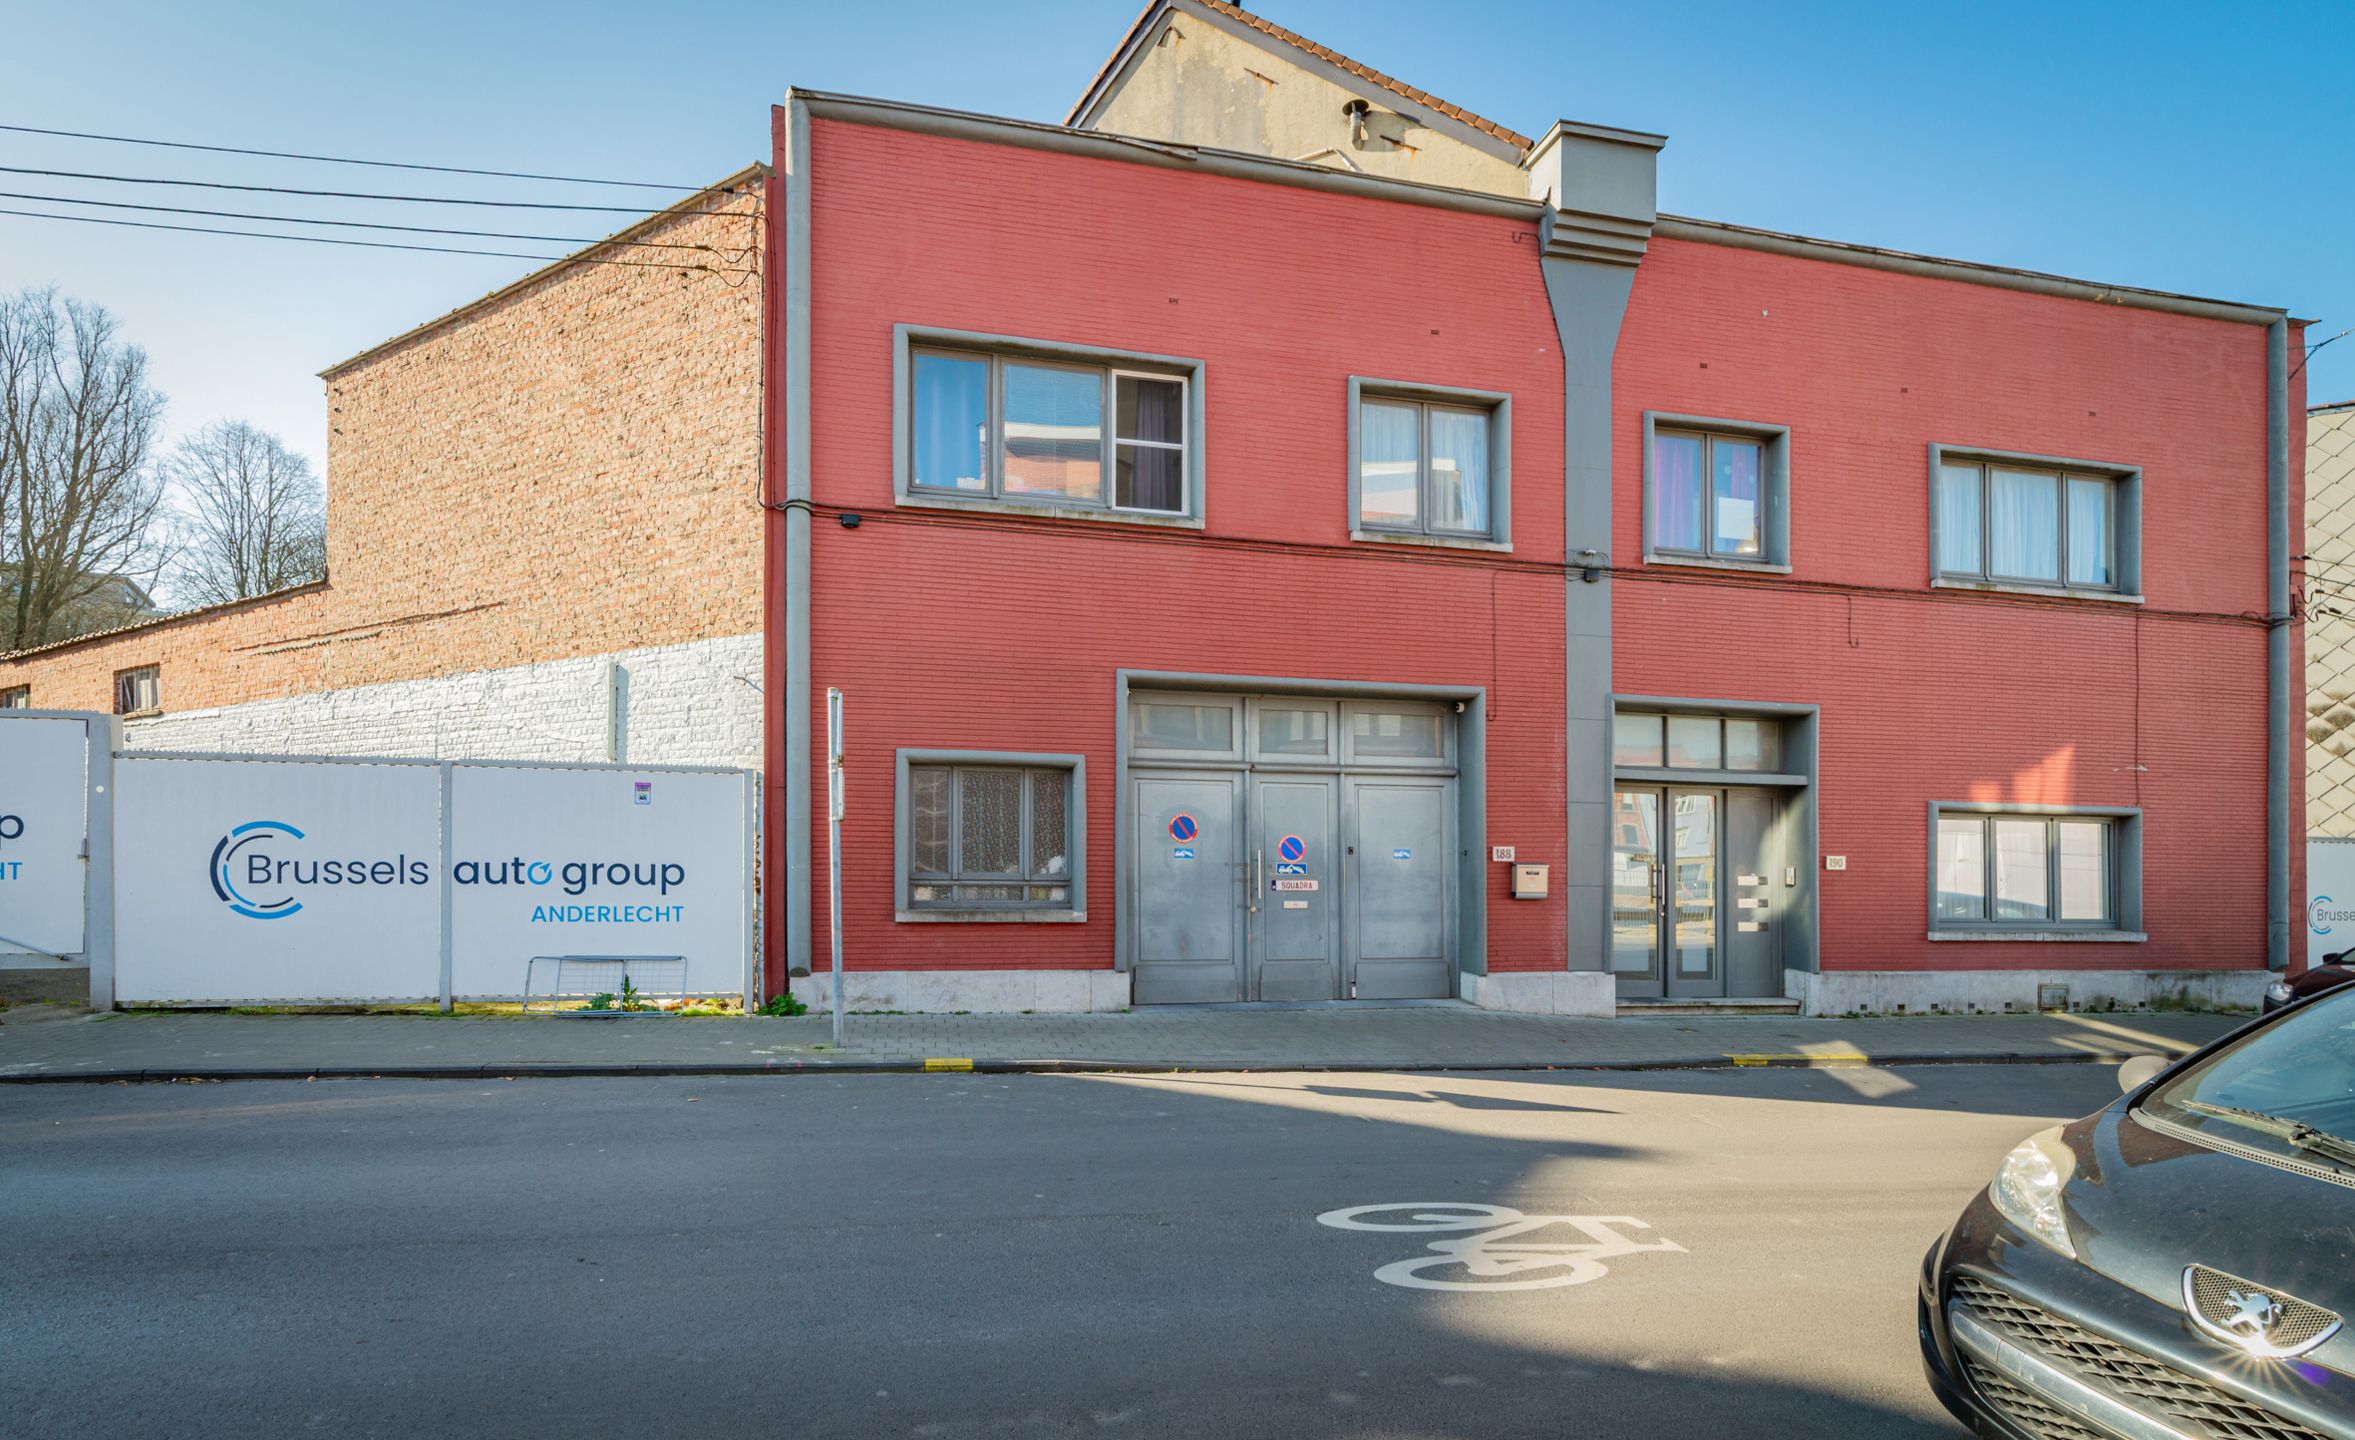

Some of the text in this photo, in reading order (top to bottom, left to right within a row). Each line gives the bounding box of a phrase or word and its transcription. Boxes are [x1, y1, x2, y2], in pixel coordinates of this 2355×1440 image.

[1495, 849, 1512, 859] 188
[1829, 858, 1844, 868] 190
[247, 854, 686, 896] Brussels auto group
[1281, 881, 1313, 889] SQUADRA
[531, 905, 685, 923] ANDERLECHT
